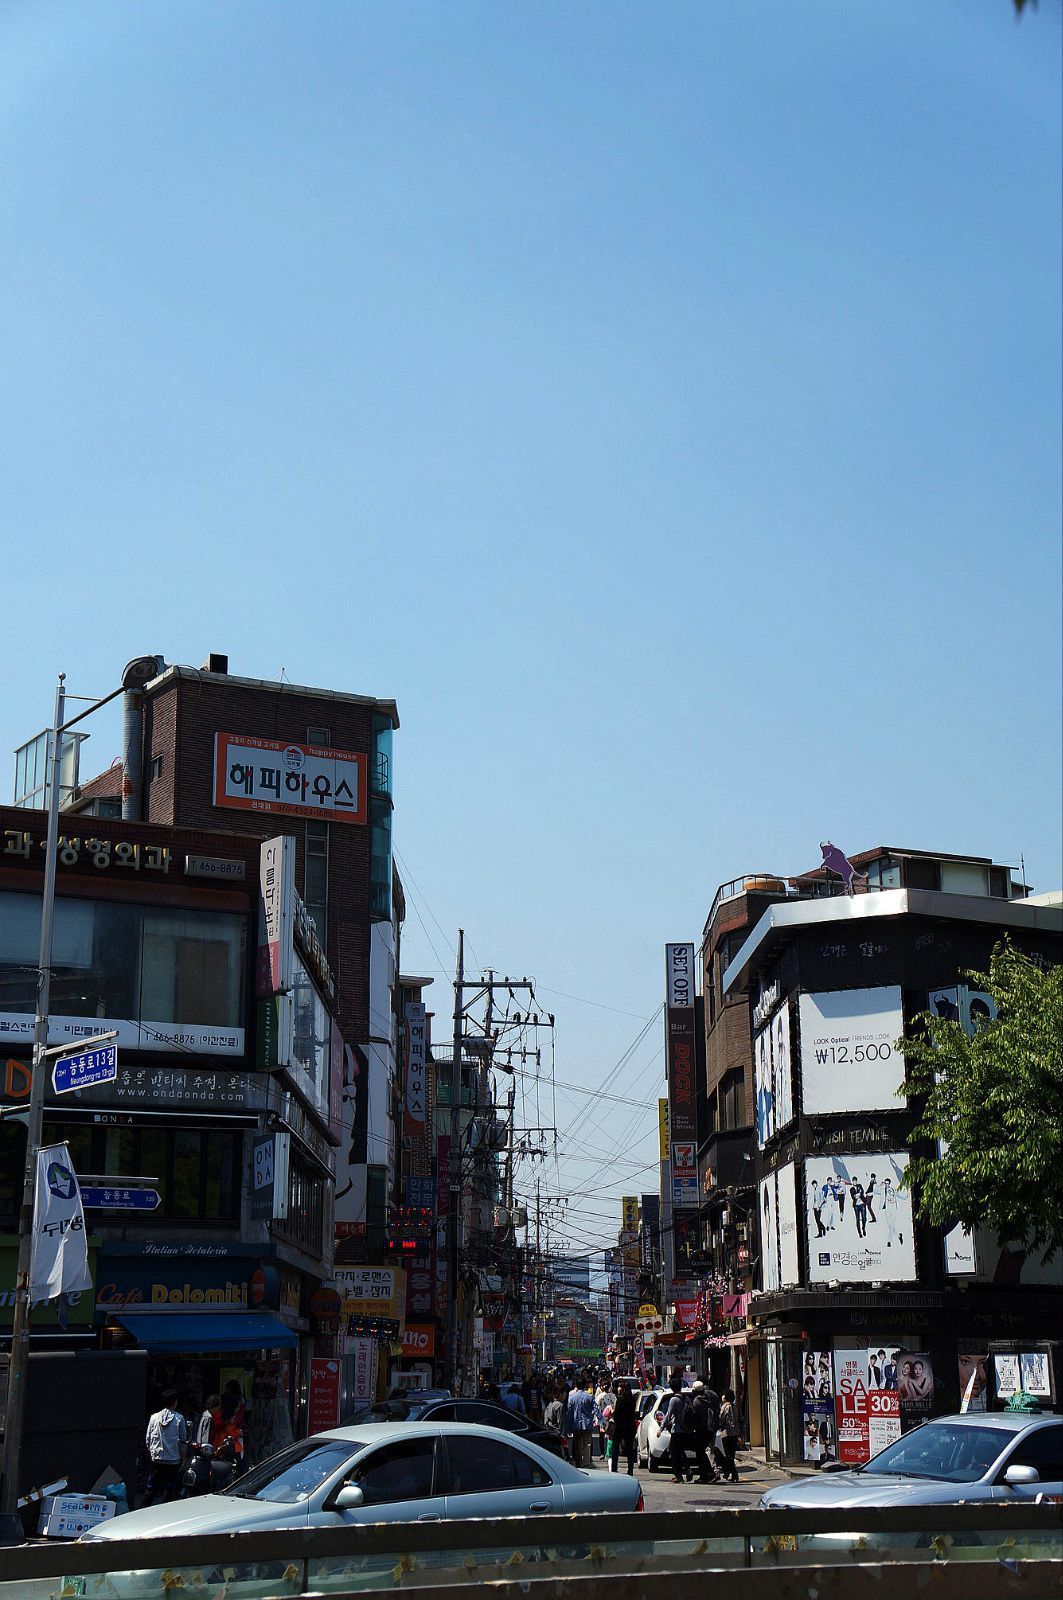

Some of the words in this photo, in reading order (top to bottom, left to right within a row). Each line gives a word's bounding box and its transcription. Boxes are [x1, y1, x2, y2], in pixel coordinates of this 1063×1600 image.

[230, 763, 355, 808] 해피하우스
[198, 863, 244, 878] 466-8875
[673, 947, 688, 975] SET
[673, 978, 689, 1007] OFF
[671, 1023, 687, 1031] Bar
[70, 1048, 115, 1076] 능동로13길
[411, 1025, 423, 1113] 해피하우스
[117, 1088, 245, 1103] www.ondaonda.com
[832, 1252, 858, 1266] 안경은
[152, 1281, 248, 1304] Dolomiti
[839, 1378, 867, 1396] SA
[842, 1395, 867, 1414] LE
[61, 1501, 101, 1512] seaborn
